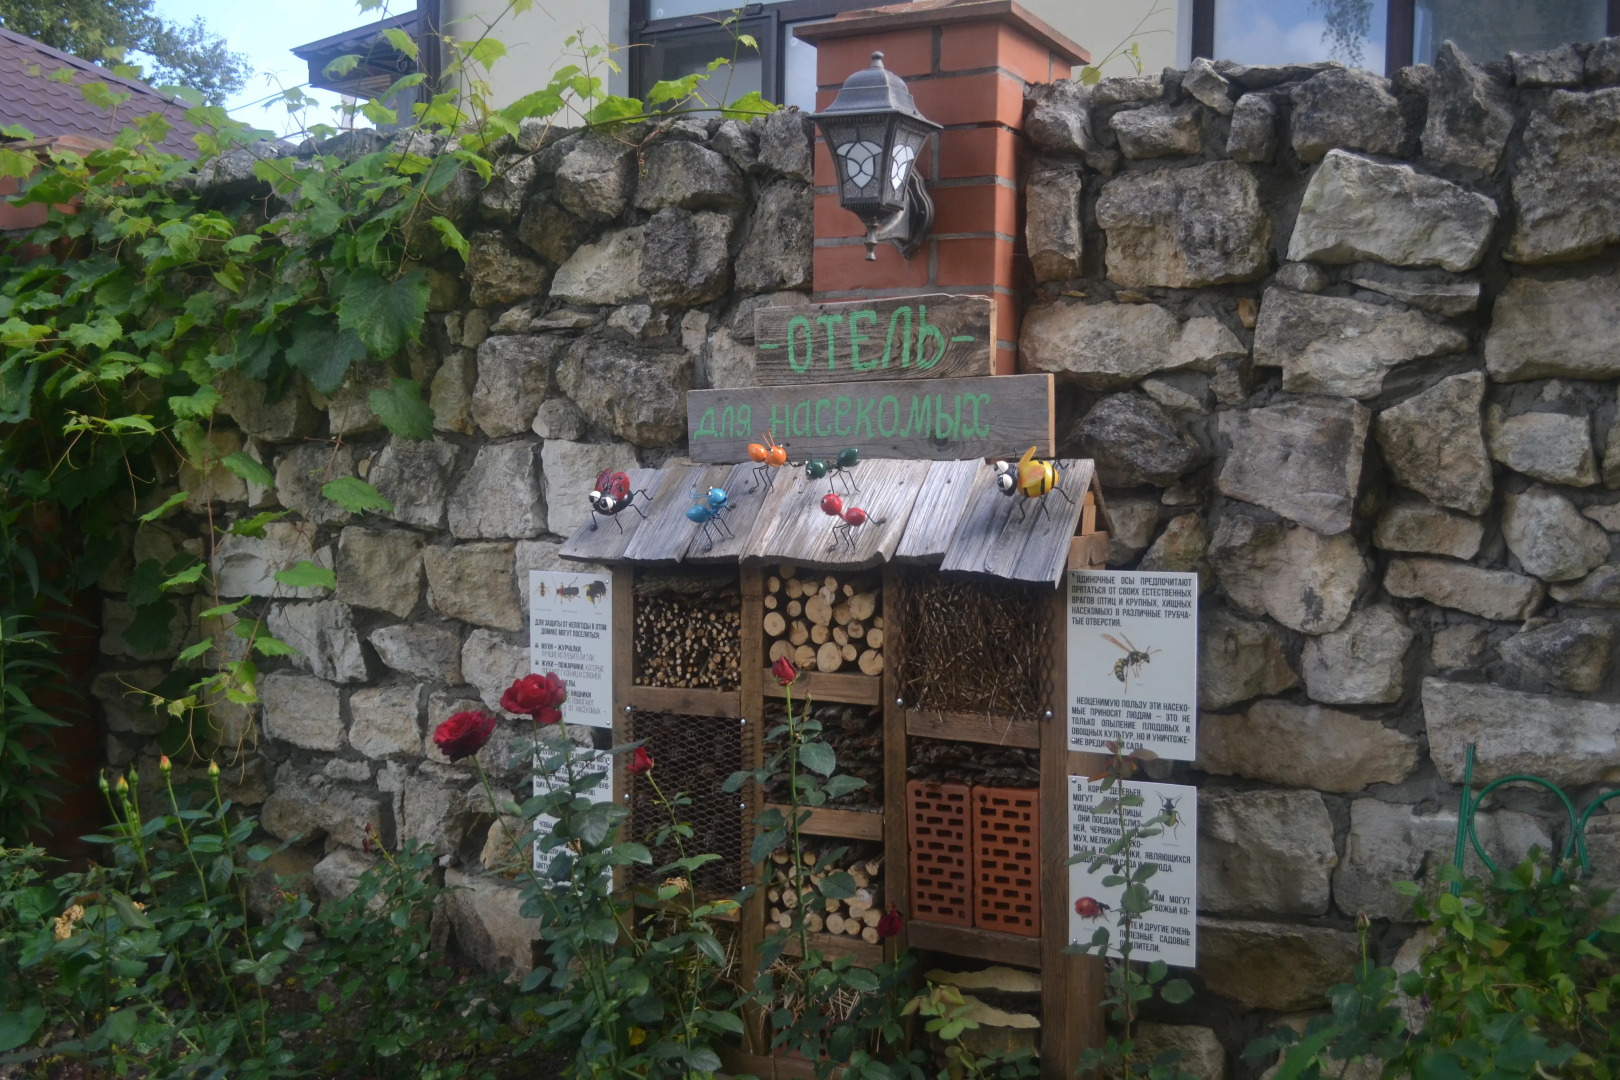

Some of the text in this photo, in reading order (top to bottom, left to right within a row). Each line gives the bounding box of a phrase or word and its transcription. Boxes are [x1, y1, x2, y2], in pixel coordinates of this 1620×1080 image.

[1076, 575, 1192, 587] ОДИНОЧНЫЕ ОСЫ ПРЕДПОЧИТАЮТ
[1071, 585, 1192, 597] ПРЯТАТЬСЯ ОТ СВОИХ ЕСТЕСТВЕННЫХ
[1071, 595, 1095, 604] ВРАГОВ
[1161, 599, 1192, 609] ХИЩНЫХ
[1122, 608, 1161, 618] РАЗЛИЧНЫЕ
[1071, 616, 1122, 627] ТЫЕ ОТВЕРСТИЯ.
[1076, 696, 1191, 712] НЕОЦЕНИМУЮ ПОЛЬЗУ ЭТИ НАСЕКО-
[1071, 707, 1085, 715] МЫЕ
[1090, 708, 1122, 718] ПРИНОСЯТ
[1126, 710, 1151, 720] ЛЮДЯМ
[1165, 713, 1178, 722] ЭТО
[1182, 714, 1190, 723] НЕ
[1071, 717, 1095, 726] ТОЛЬКО
[1101, 719, 1136, 729] ОПЫЛЕНИЕ
[1142, 722, 1179, 733] ПЛОДОВЫХ
[1071, 727, 1102, 737] ОВОЩНЫХ
[1136, 732, 1145, 741] НО
[1077, 783, 1082, 791] В
[1073, 793, 1093, 802] МОГУТ
[1078, 814, 1090, 823] ОНИ
[1092, 815, 1121, 826] ПОЕДАЮТ
[1145, 851, 1191, 863] ЯВЛЯЮЩИХСЯ
[1169, 895, 1190, 905] МОГУТ
[1180, 906, 1191, 915] КО-
[1144, 923, 1169, 934] ДРУГИЕ
[1170, 926, 1191, 936] ОЧЕНЬ
[1160, 934, 1191, 946] САДОВЫЕ
